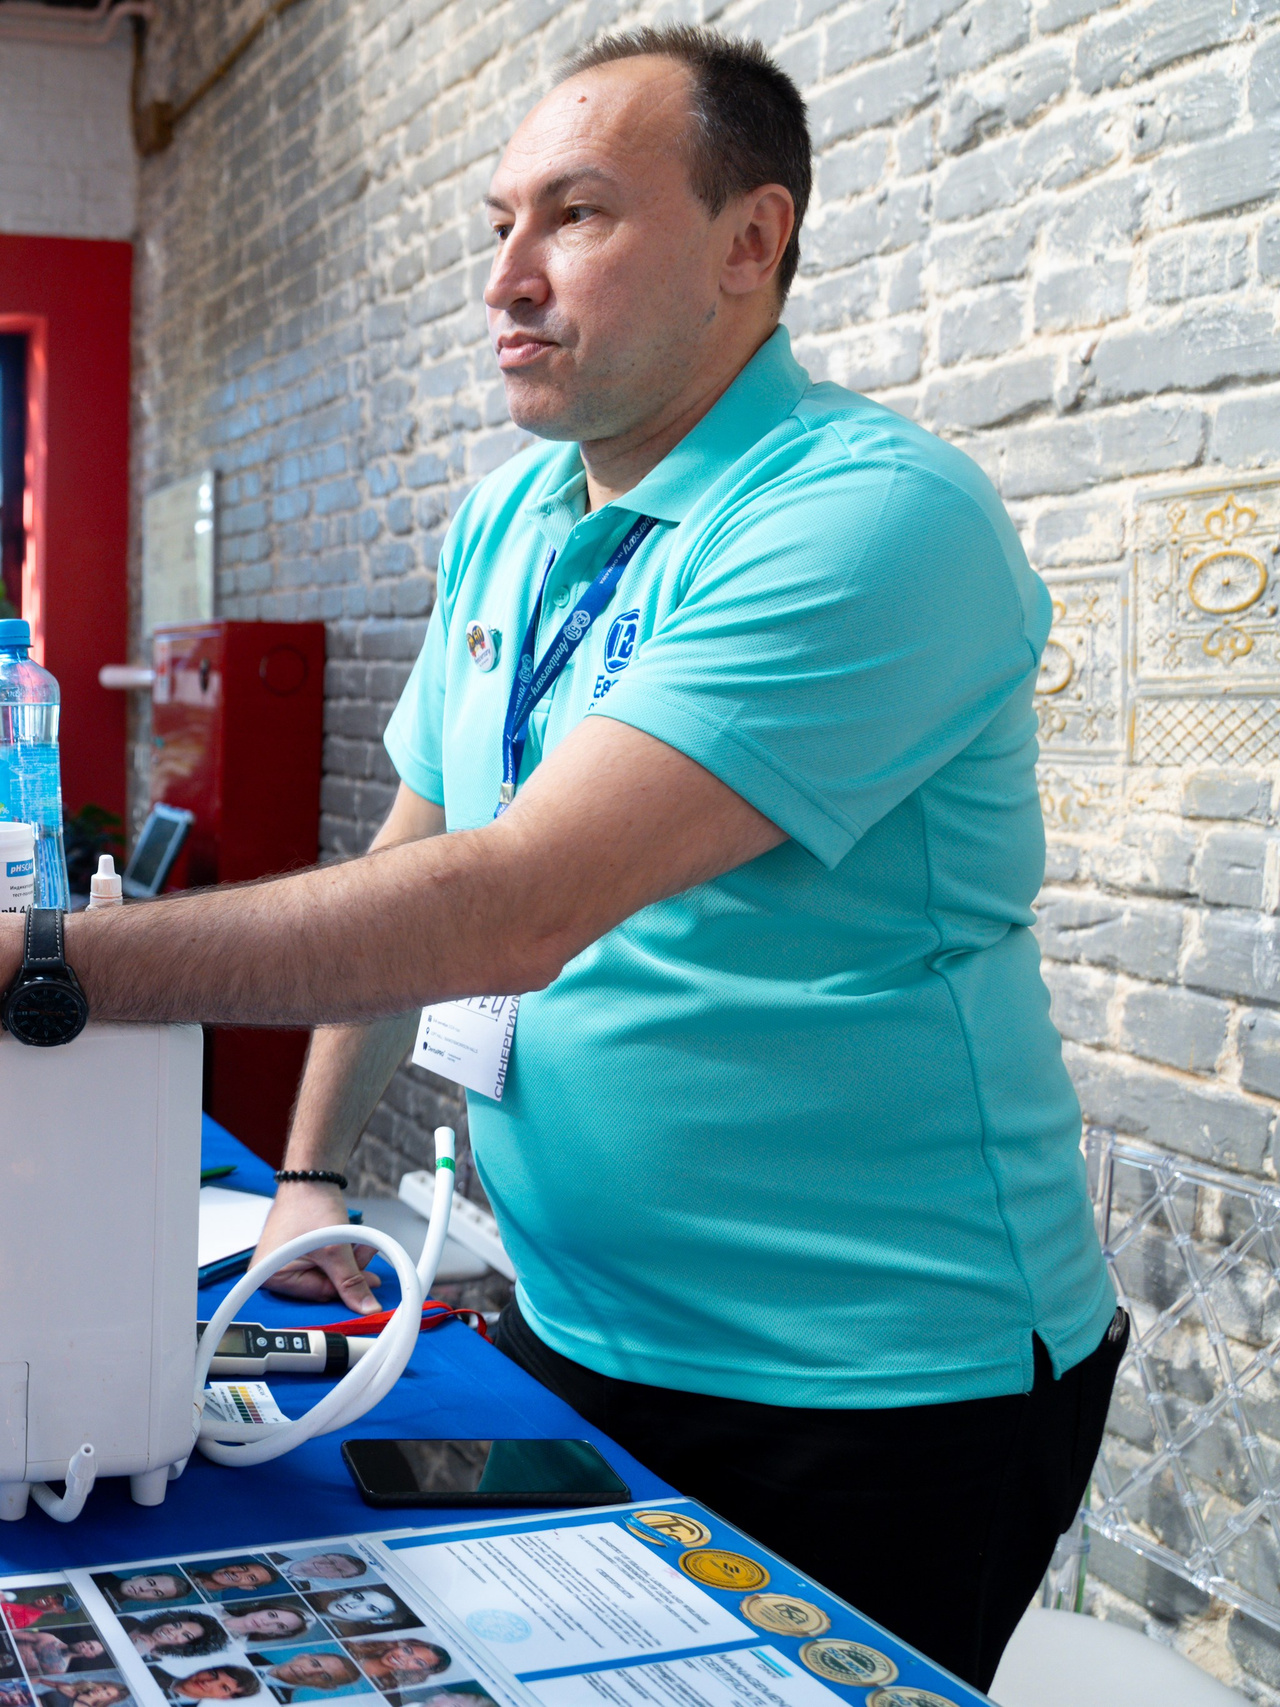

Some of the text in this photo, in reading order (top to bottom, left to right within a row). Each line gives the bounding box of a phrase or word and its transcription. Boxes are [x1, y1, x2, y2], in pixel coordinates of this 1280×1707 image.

[621, 517, 656, 555] iversary
[599, 558, 619, 585] OKINAWA
[530, 637, 569, 696] Anniversary
[849, 1643, 888, 1672] QUALITY
[717, 1654, 792, 1707] MANAGEMEN
